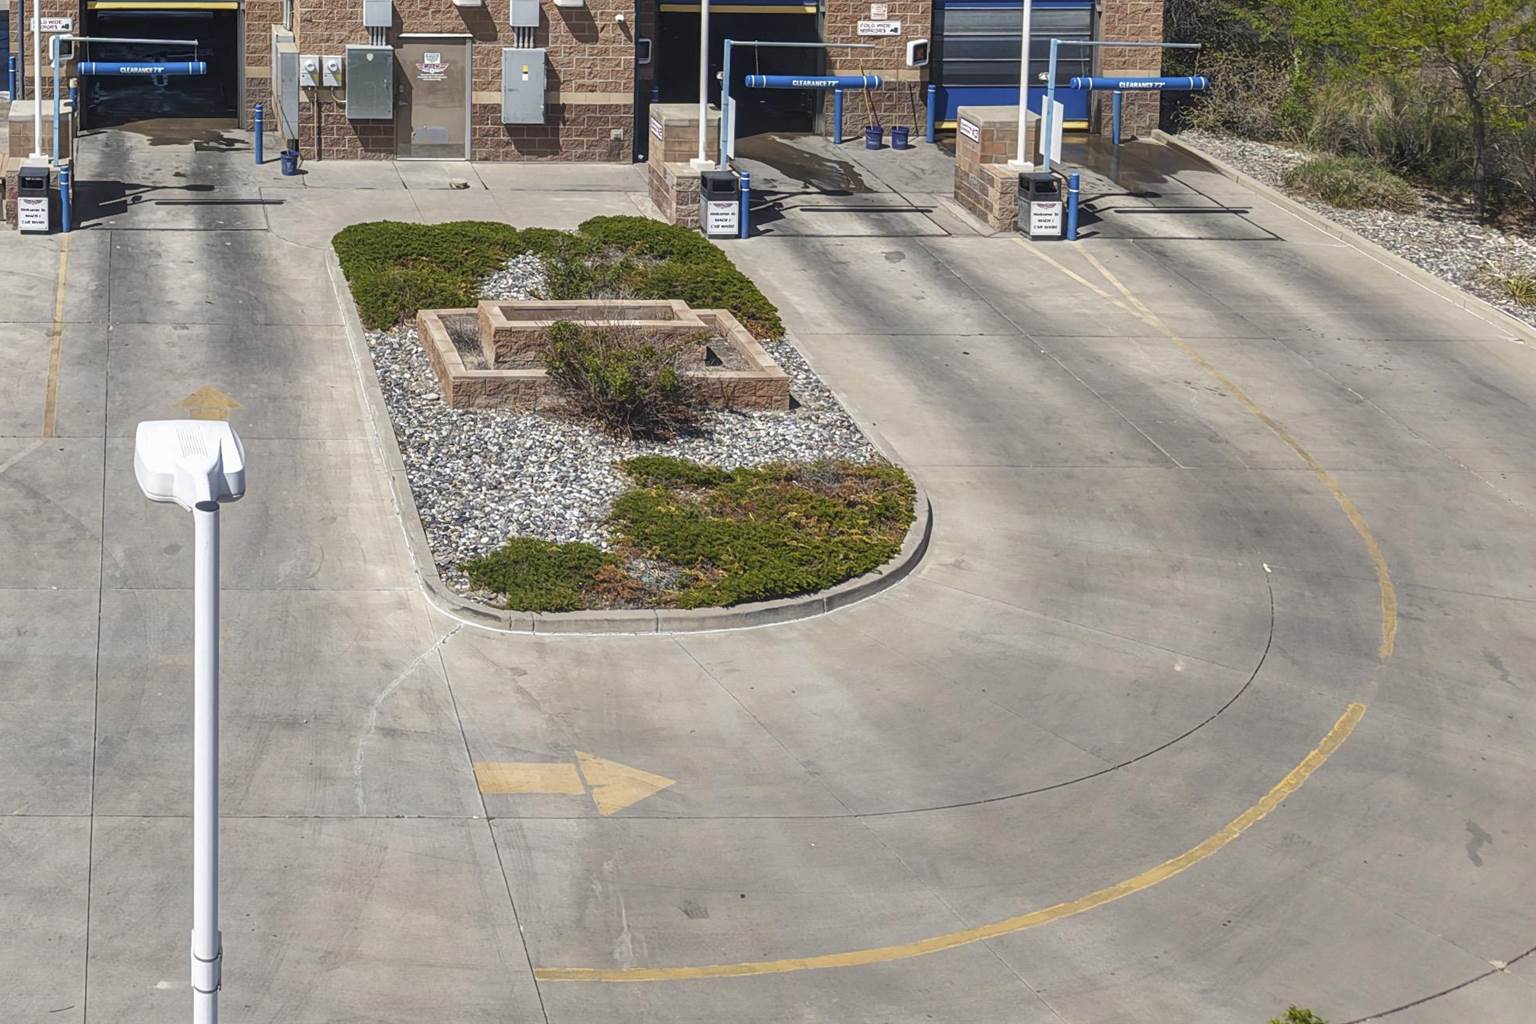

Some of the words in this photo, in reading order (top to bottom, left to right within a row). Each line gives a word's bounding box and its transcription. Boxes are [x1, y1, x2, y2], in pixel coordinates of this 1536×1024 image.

[119, 66, 152, 74] CLEARANCE
[792, 79, 827, 87] CLEARANCE
[1118, 81, 1152, 89] CLEARANCE
